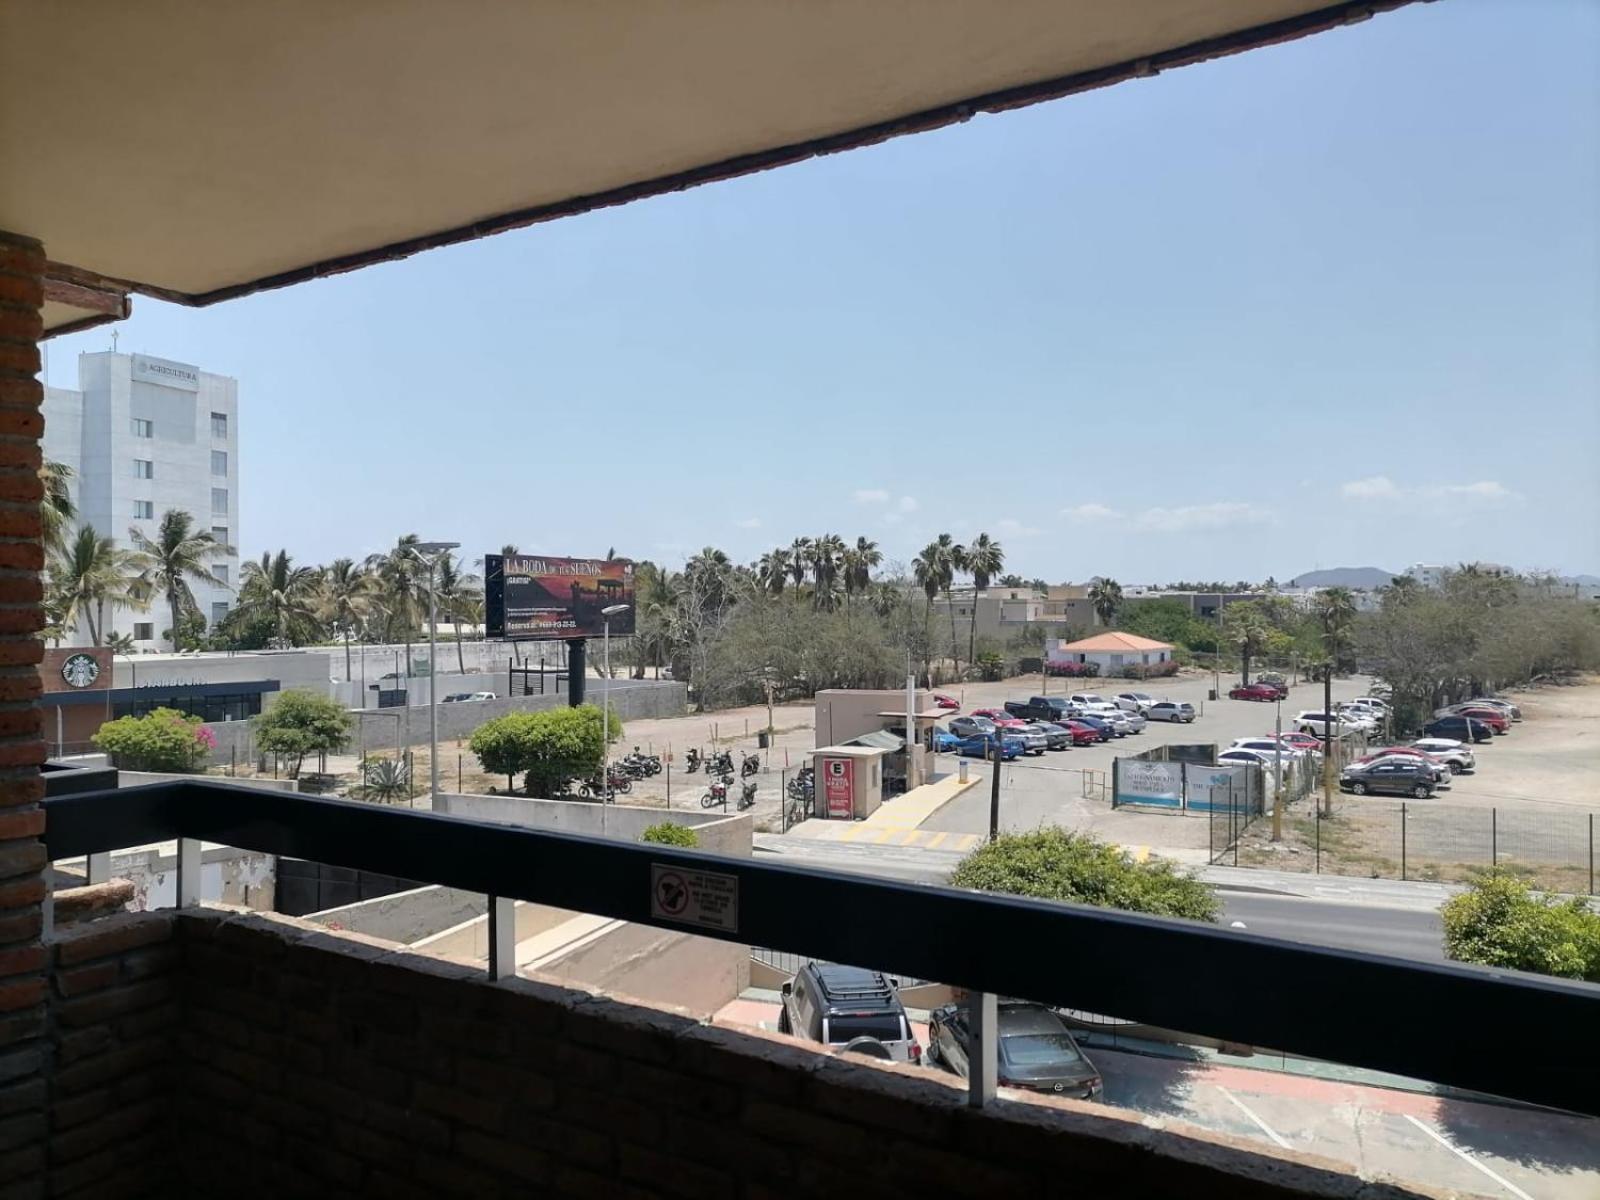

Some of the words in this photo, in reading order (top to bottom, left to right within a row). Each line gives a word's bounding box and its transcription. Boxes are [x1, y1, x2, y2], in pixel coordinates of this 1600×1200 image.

[150, 364, 197, 381] AGRICULTURA
[506, 559, 519, 573] LA
[522, 560, 546, 574] BODA
[570, 560, 601, 576] SUEÑOS
[833, 763, 842, 774] E
